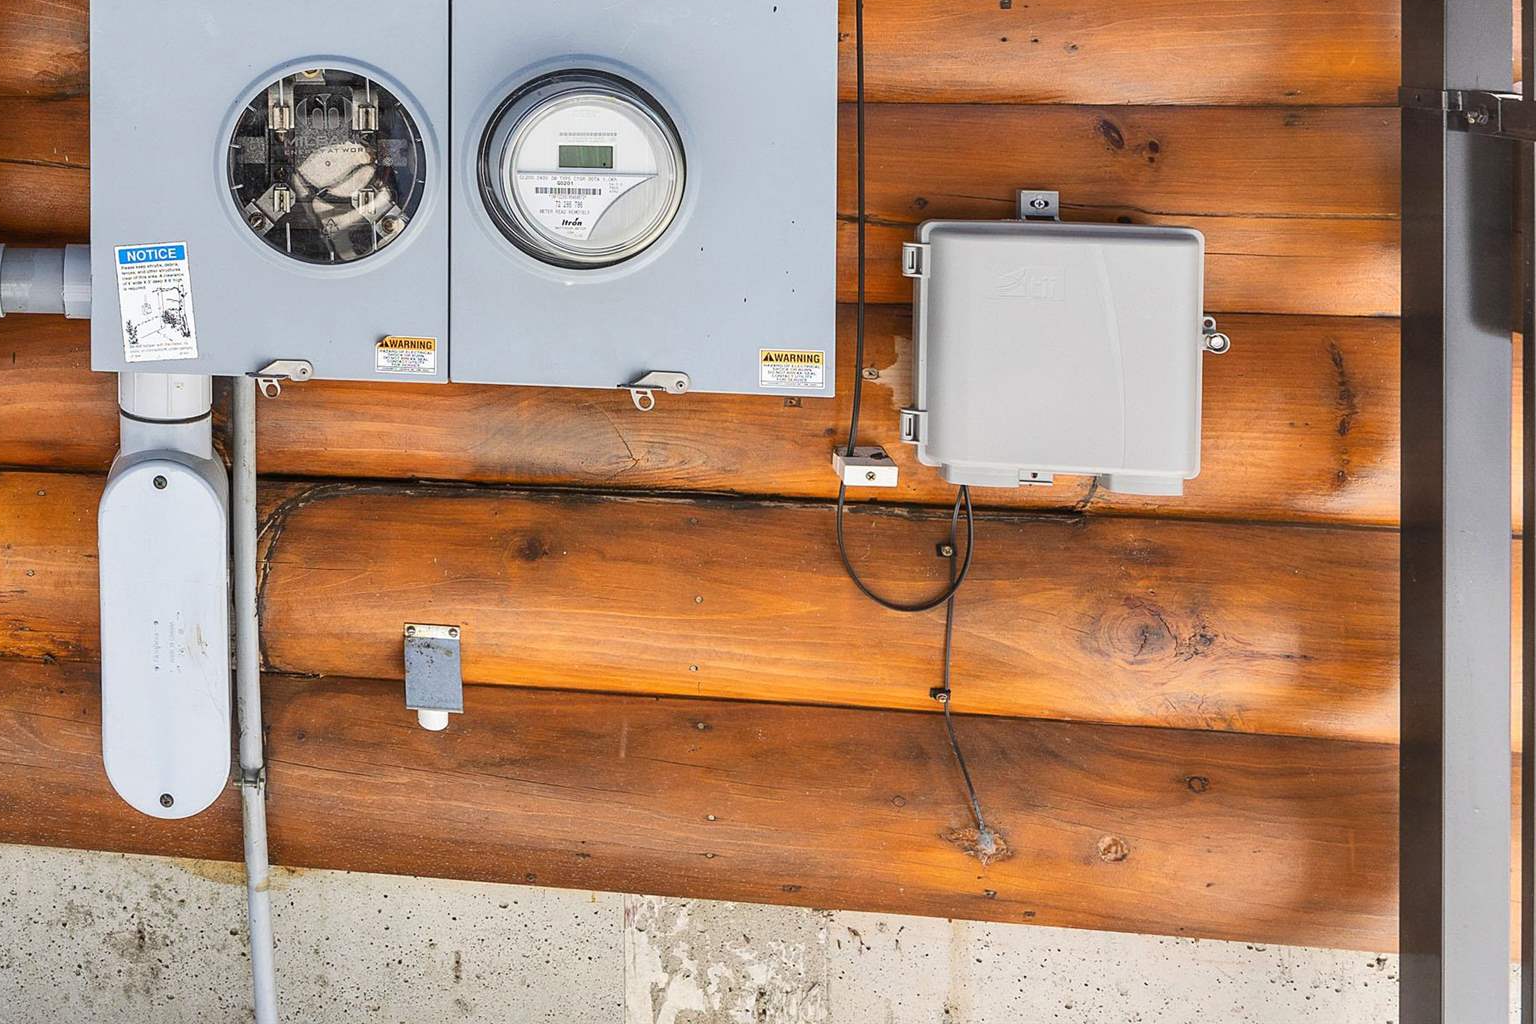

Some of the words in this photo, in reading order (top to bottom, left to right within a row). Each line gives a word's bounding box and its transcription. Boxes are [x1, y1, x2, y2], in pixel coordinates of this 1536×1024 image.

[562, 218, 582, 226] Itron
[127, 248, 177, 262] NOTICE
[389, 339, 432, 350] WARNING
[775, 354, 820, 363] WARNING
